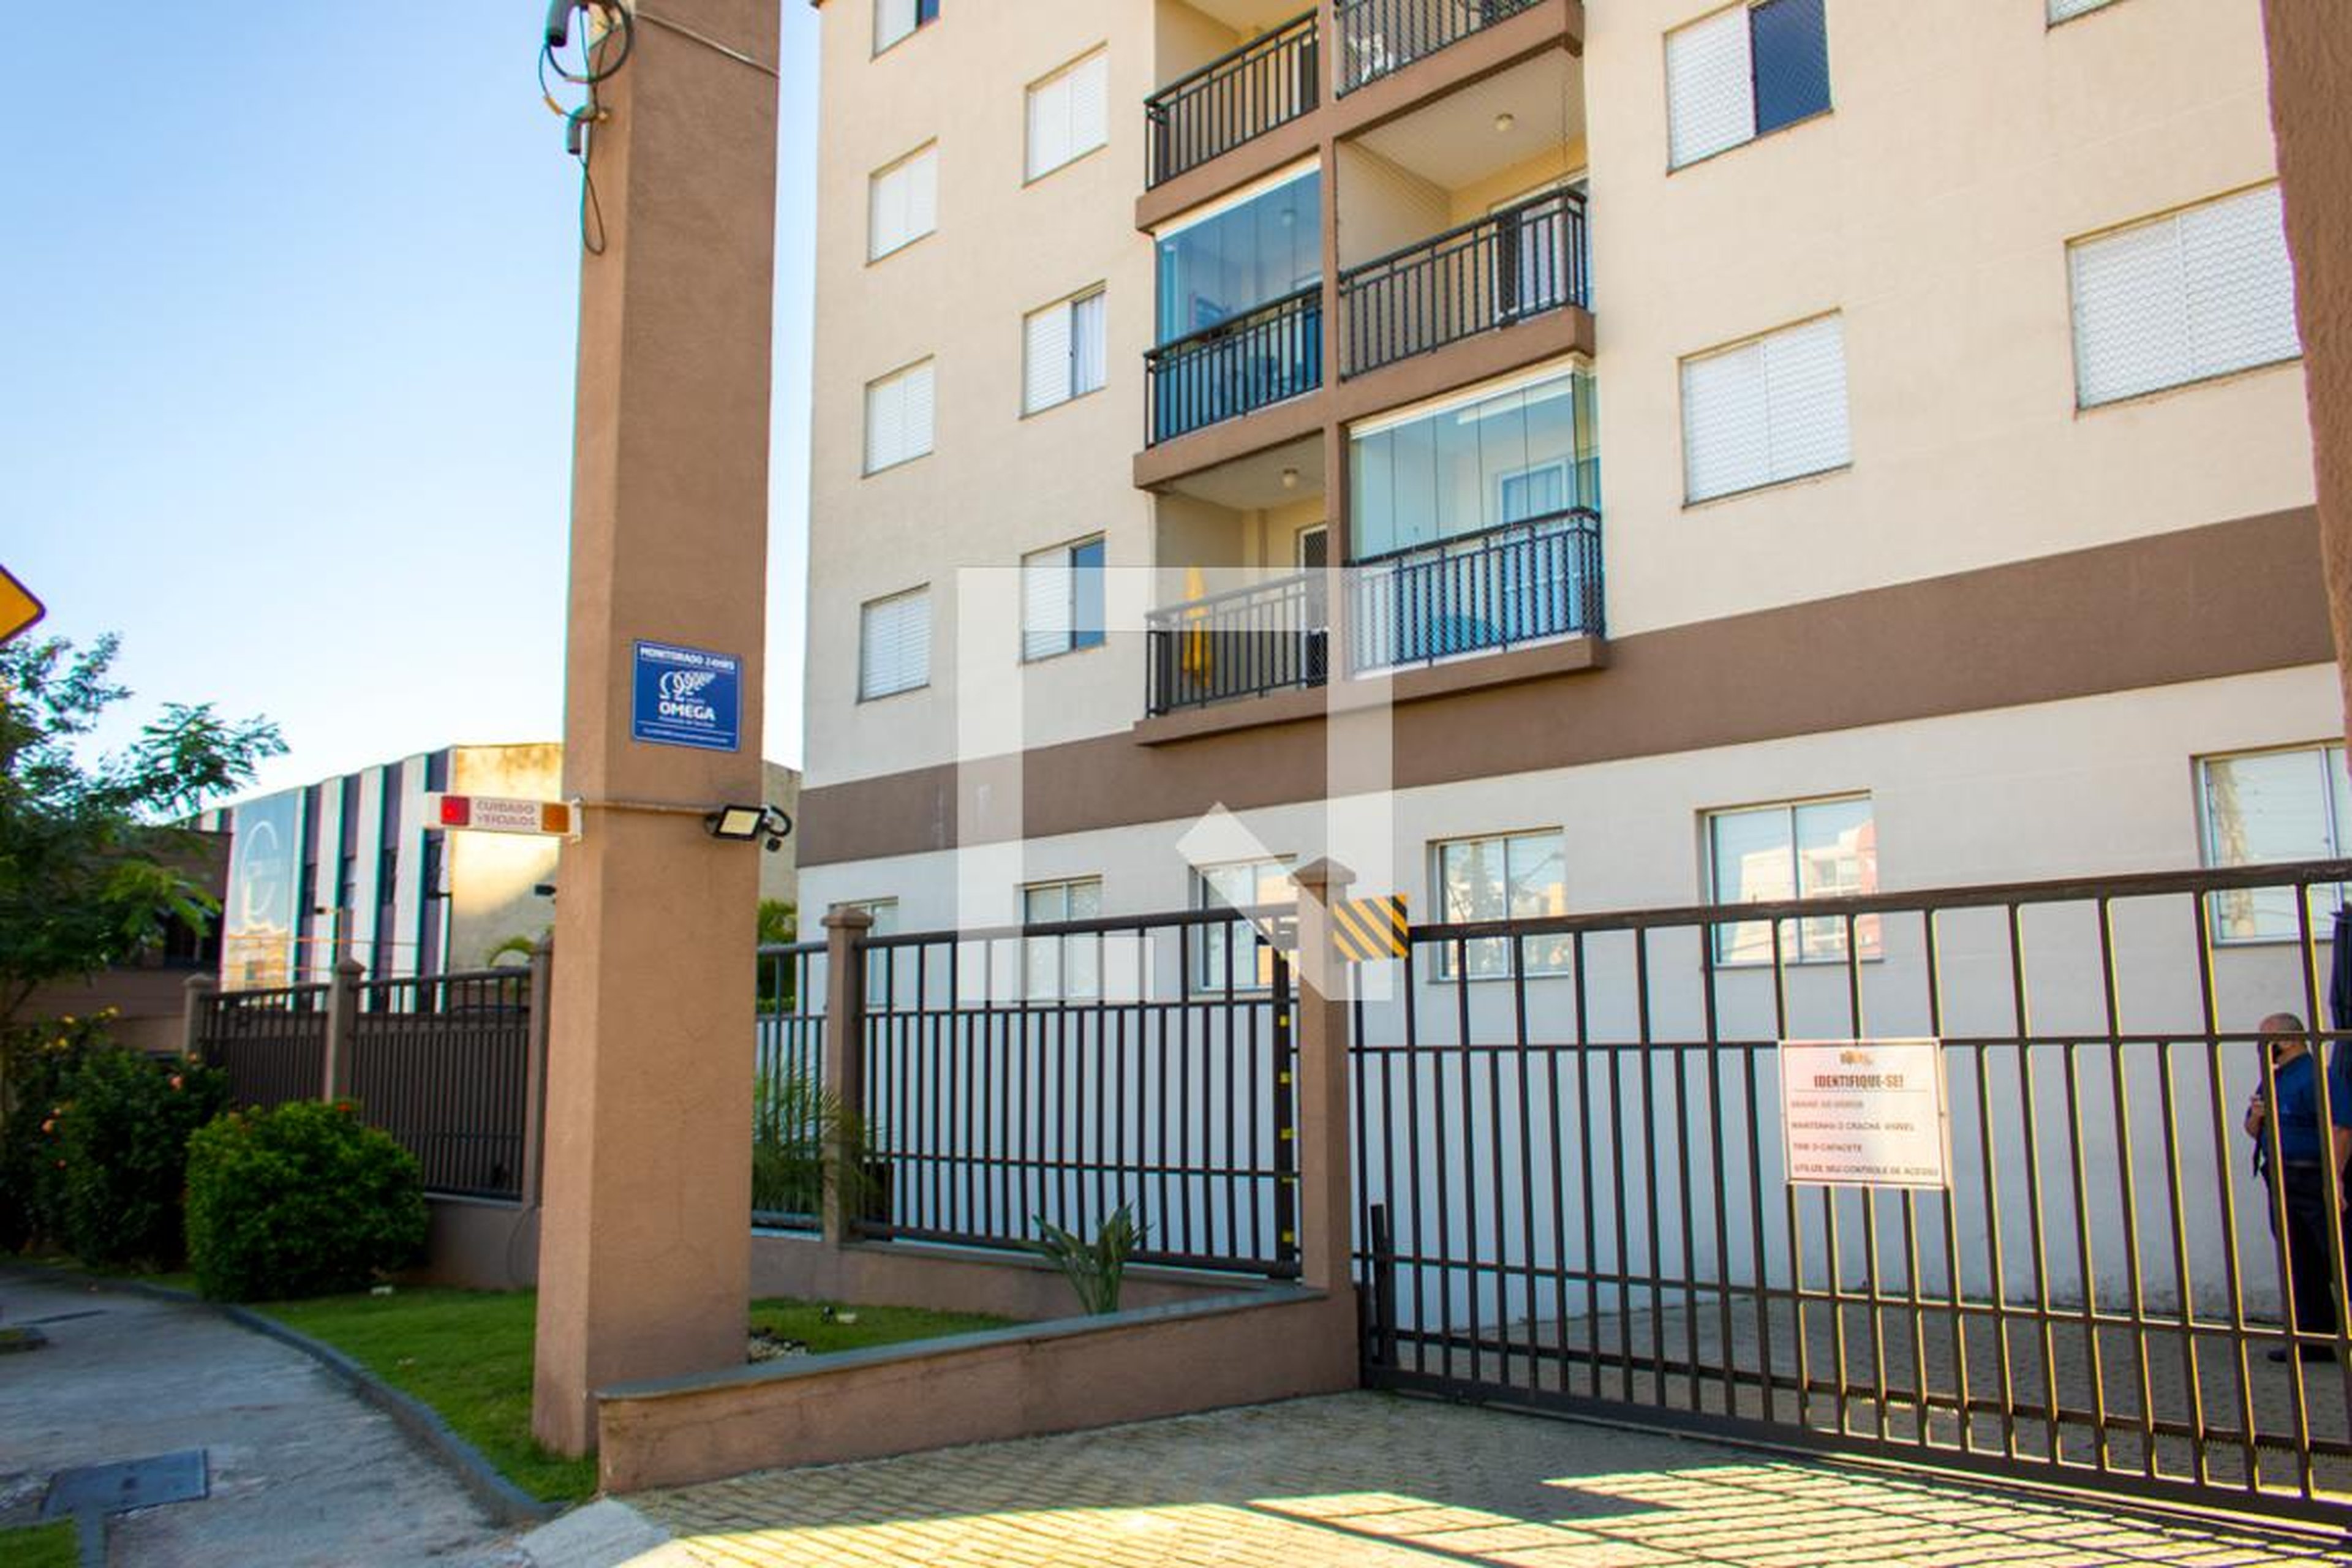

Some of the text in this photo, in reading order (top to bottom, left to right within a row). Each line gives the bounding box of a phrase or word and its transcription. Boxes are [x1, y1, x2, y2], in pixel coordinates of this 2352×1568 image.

[659, 701, 715, 720] OMEGA
[476, 800, 535, 815] CUIDADO
[1814, 1074, 1904, 1088] IDENTIFIQUE-SE!
